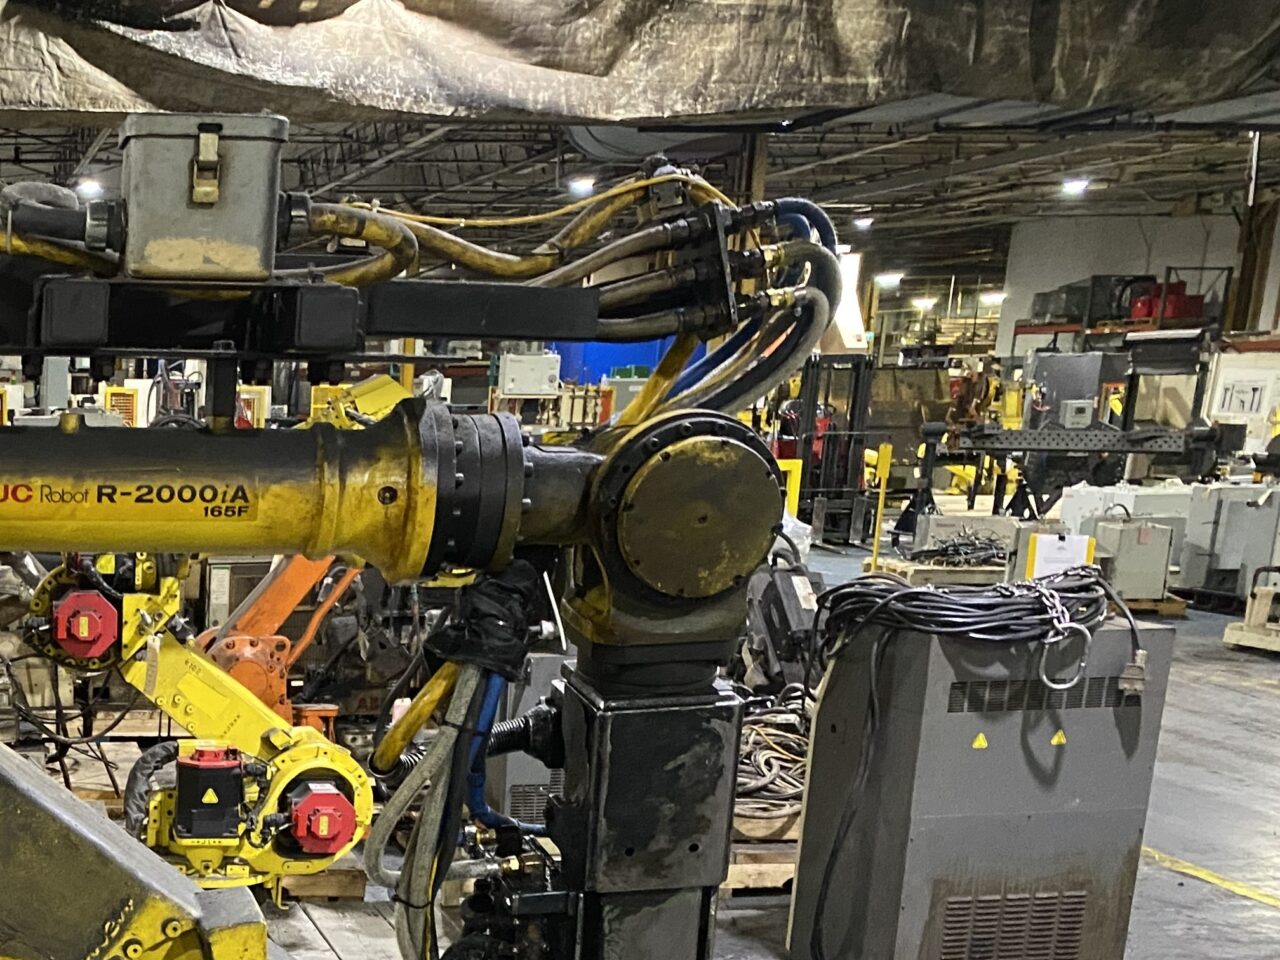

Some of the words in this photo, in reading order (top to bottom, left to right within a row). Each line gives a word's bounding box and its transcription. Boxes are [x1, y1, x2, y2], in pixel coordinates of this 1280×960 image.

[40, 485, 89, 503] Robot
[97, 484, 249, 503] R-2000iA
[204, 506, 249, 517] 165F
